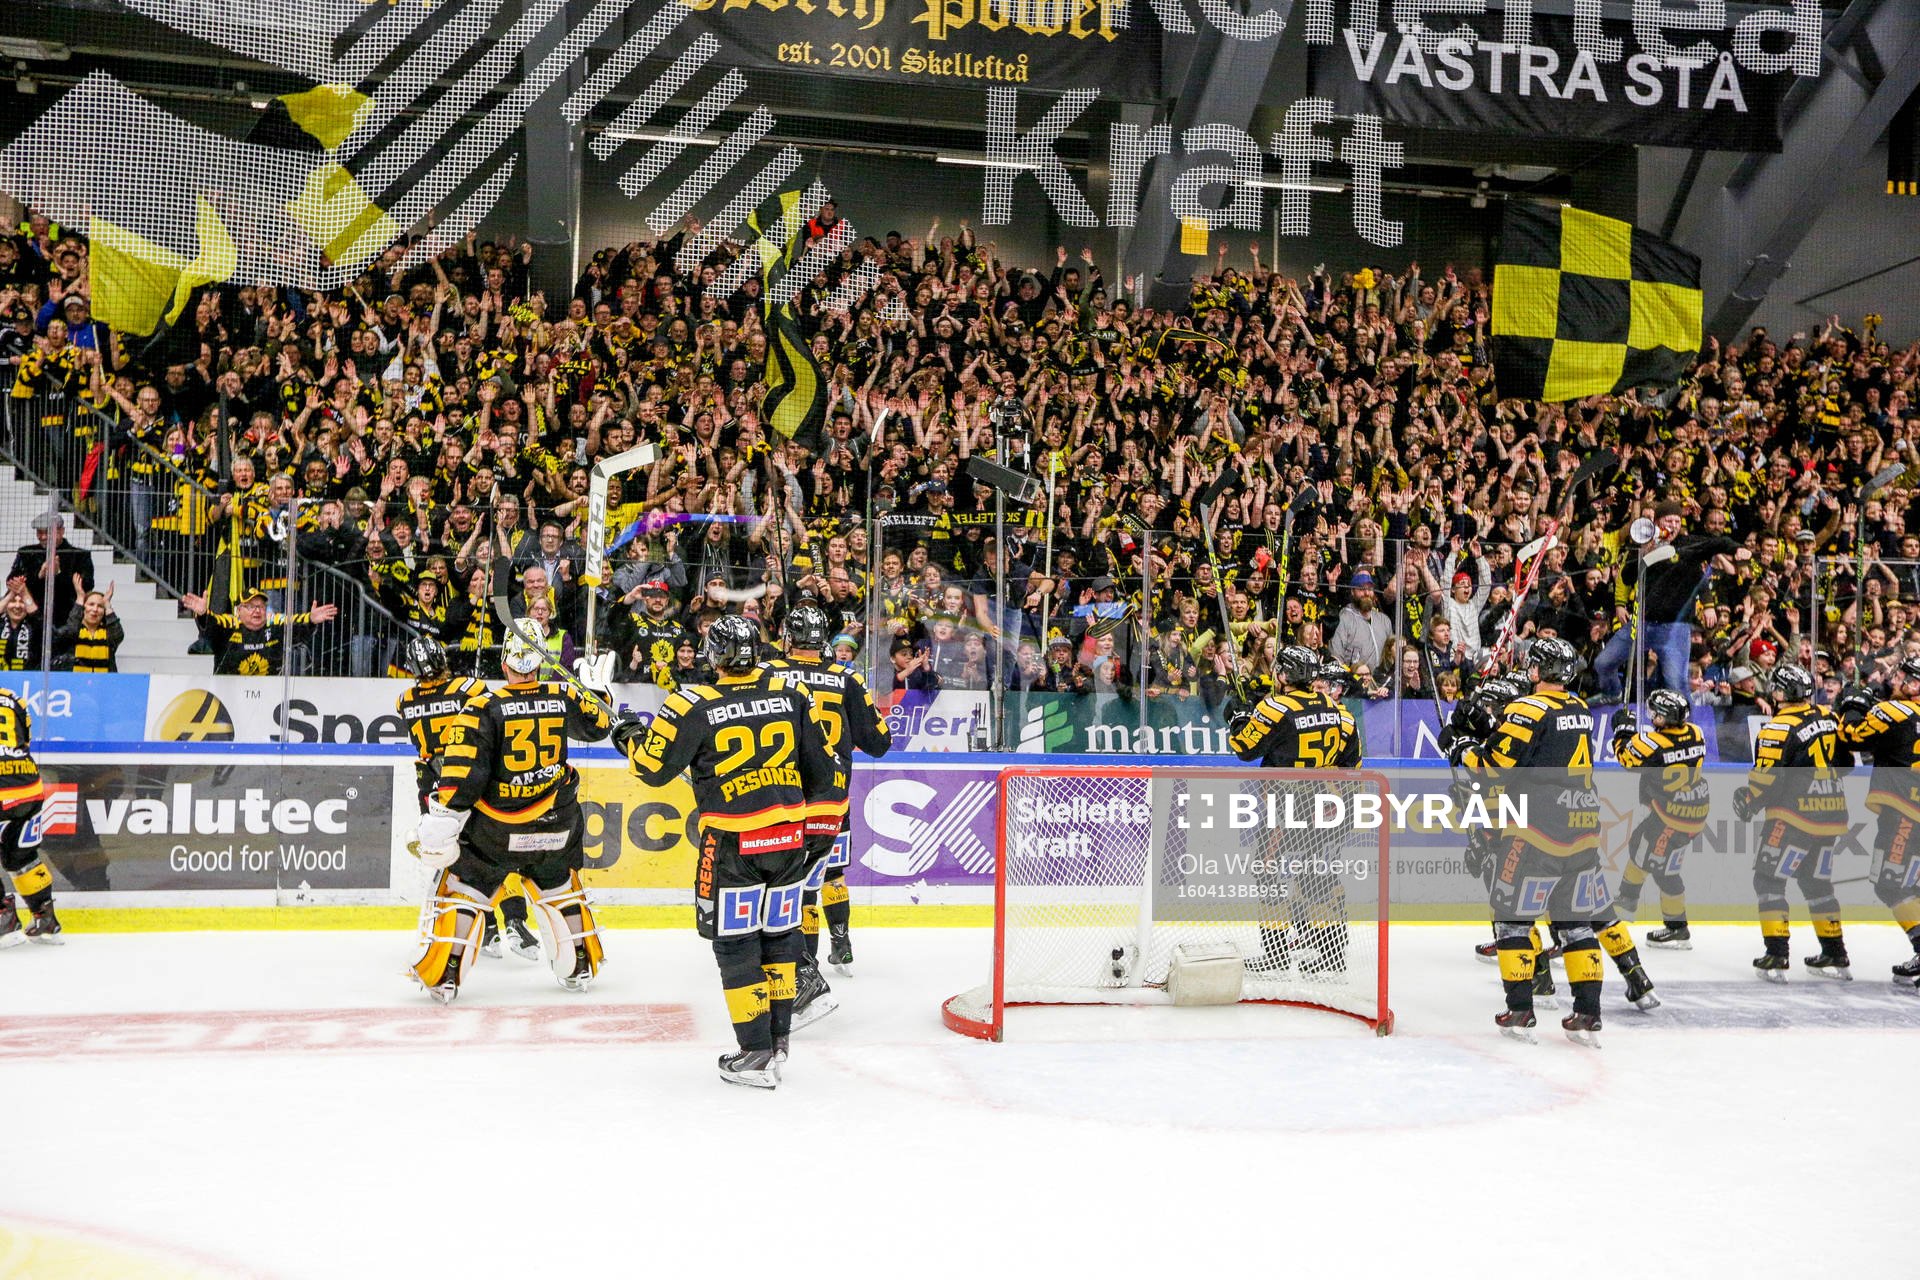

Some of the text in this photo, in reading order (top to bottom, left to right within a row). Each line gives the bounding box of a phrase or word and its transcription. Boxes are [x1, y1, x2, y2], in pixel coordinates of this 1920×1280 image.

[778, 42, 1029, 83] est. 2001 Skellefteå
[1343, 24, 1608, 102] VÄSTRA
[1624, 51, 1748, 112] STÅ
[982, 87, 1403, 248] Kraft
[245, 690, 261, 699] TM
[406, 700, 460, 719] BOLIDEN
[506, 700, 566, 715] BOLIDEN
[713, 698, 793, 724] BOLIDEN
[812, 691, 843, 746] 5
[1299, 713, 1340, 729] BOLIDEN
[503, 717, 564, 771] 35
[715, 721, 795, 776] 22
[1295, 727, 1340, 769] 52
[1568, 734, 1594, 789] 4
[1808, 733, 1838, 780] 17
[86, 783, 348, 835] valutec
[1016, 797, 1151, 823] Skellefte
[170, 845, 346, 871] Good for Wood
[1015, 831, 1091, 857] Kraft
[1889, 817, 1913, 864] REPAY
[699, 833, 717, 898] REPAY
